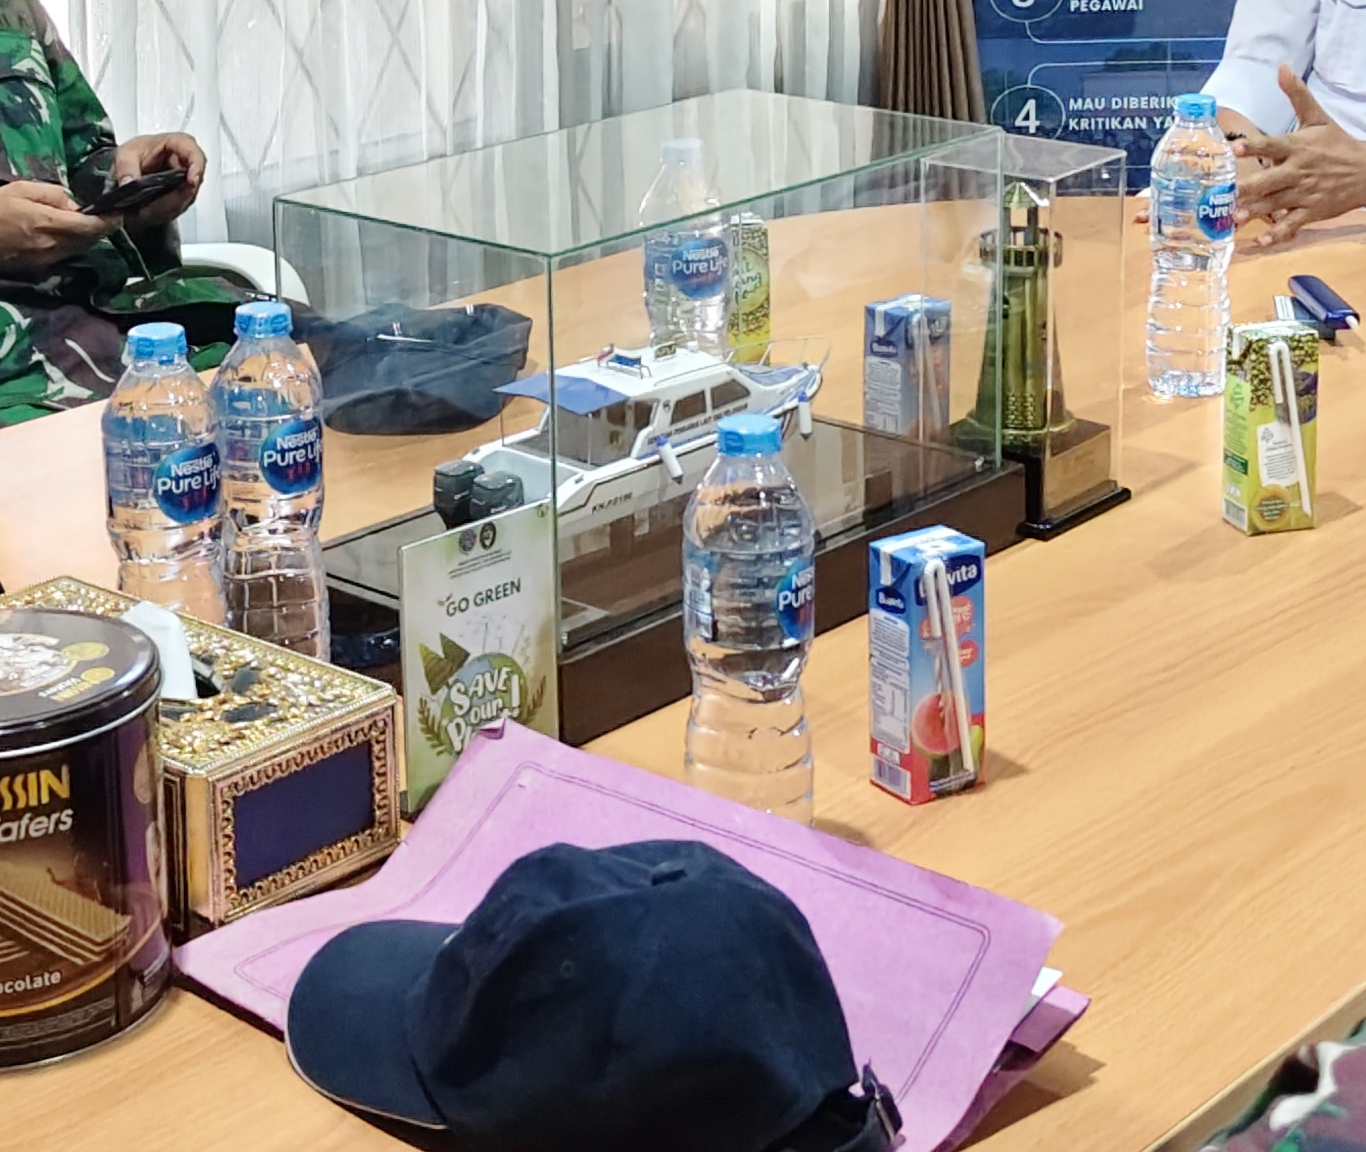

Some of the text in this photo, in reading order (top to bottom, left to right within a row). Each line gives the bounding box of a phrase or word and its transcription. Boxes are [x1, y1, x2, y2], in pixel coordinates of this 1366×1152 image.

[1068, 96, 1178, 111] MAU DIBERIK
[1014, 98, 1041, 134] 4
[1068, 116, 1175, 131] KRITIKAN YA
[672, 259, 708, 275] Pure
[263, 448, 306, 468] Pure
[157, 475, 202, 496] Pure
[446, 577, 522, 617] GO GREEN
[450, 666, 512, 716] SAVE
